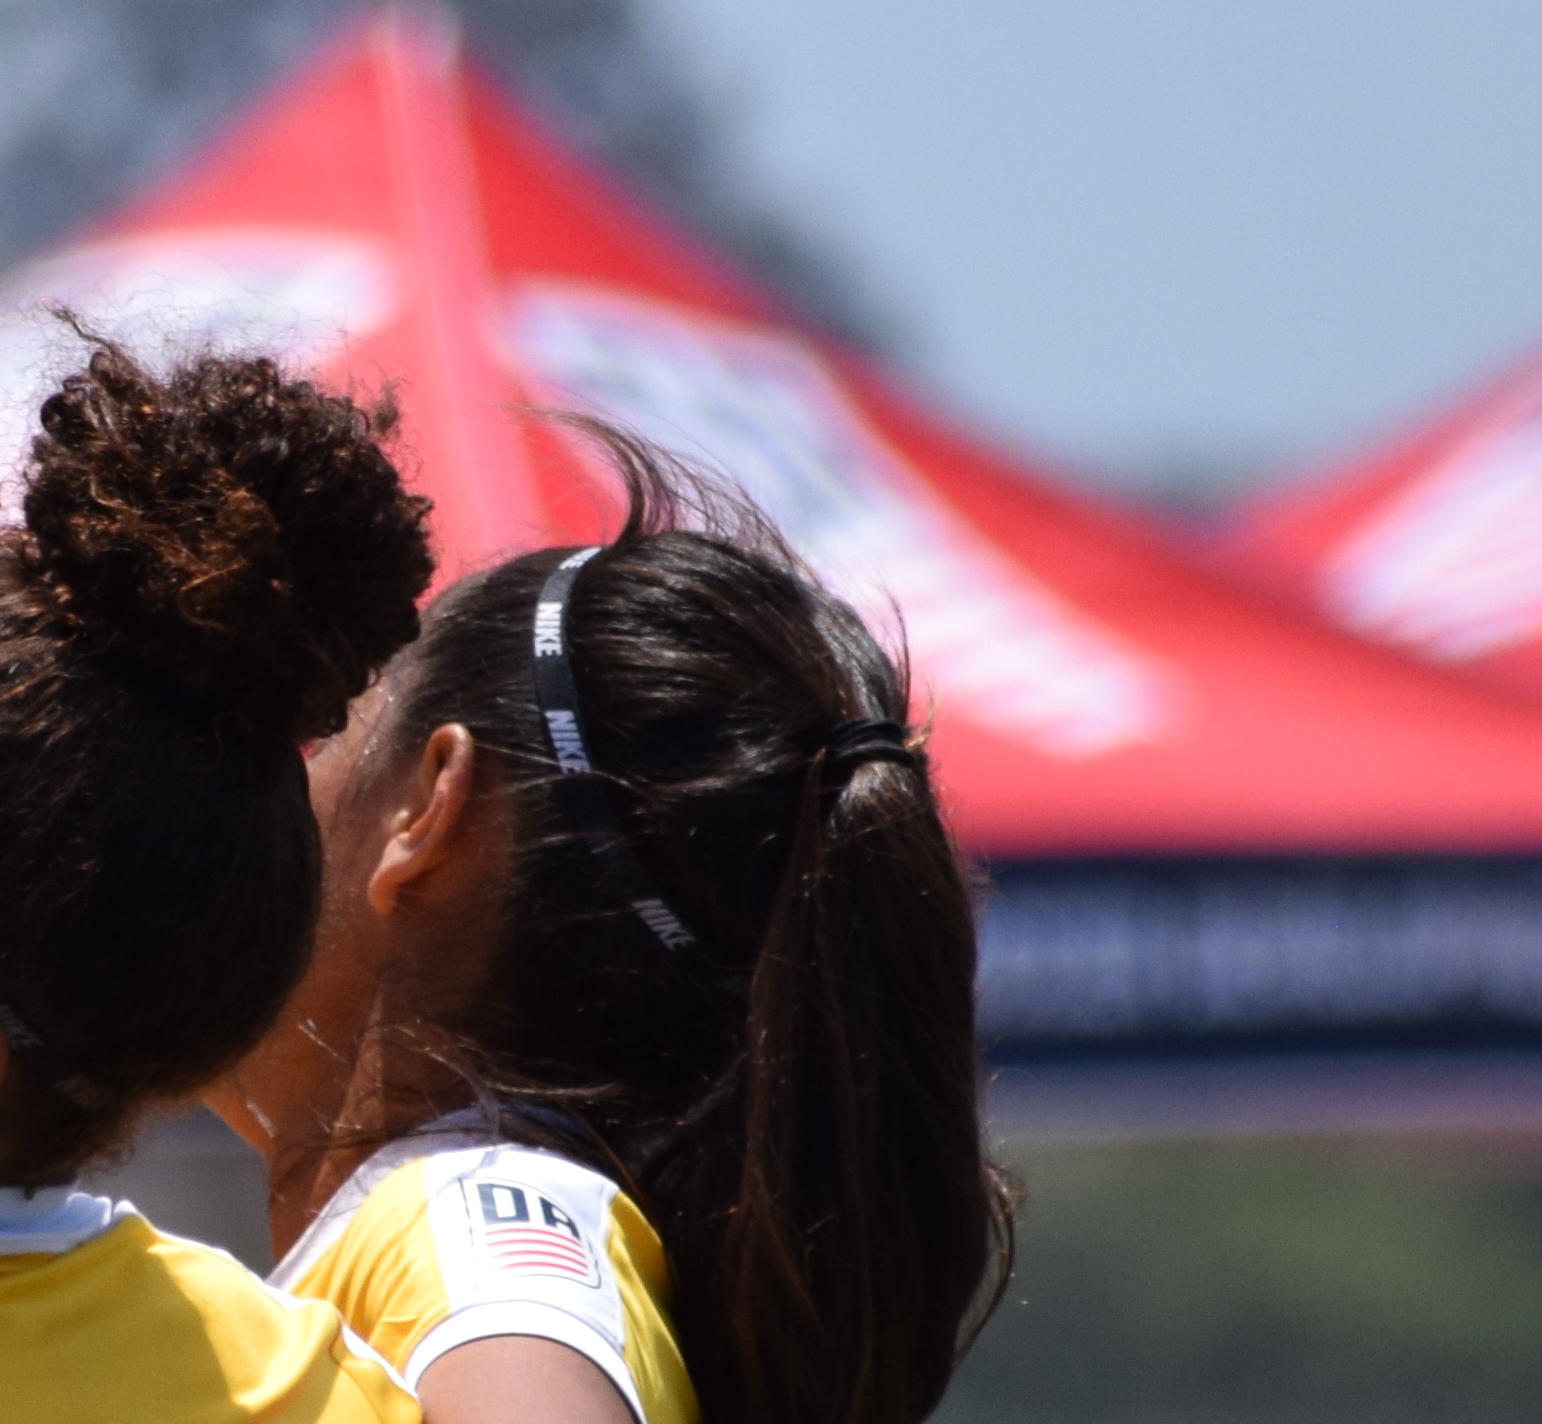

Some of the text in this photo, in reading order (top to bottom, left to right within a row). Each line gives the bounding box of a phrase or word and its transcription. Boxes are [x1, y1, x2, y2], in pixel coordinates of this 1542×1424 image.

[534, 602, 562, 657] NIKE
[545, 710, 591, 774] NIKE
[632, 899, 697, 951] NIKE
[476, 1183, 582, 1240] DA
